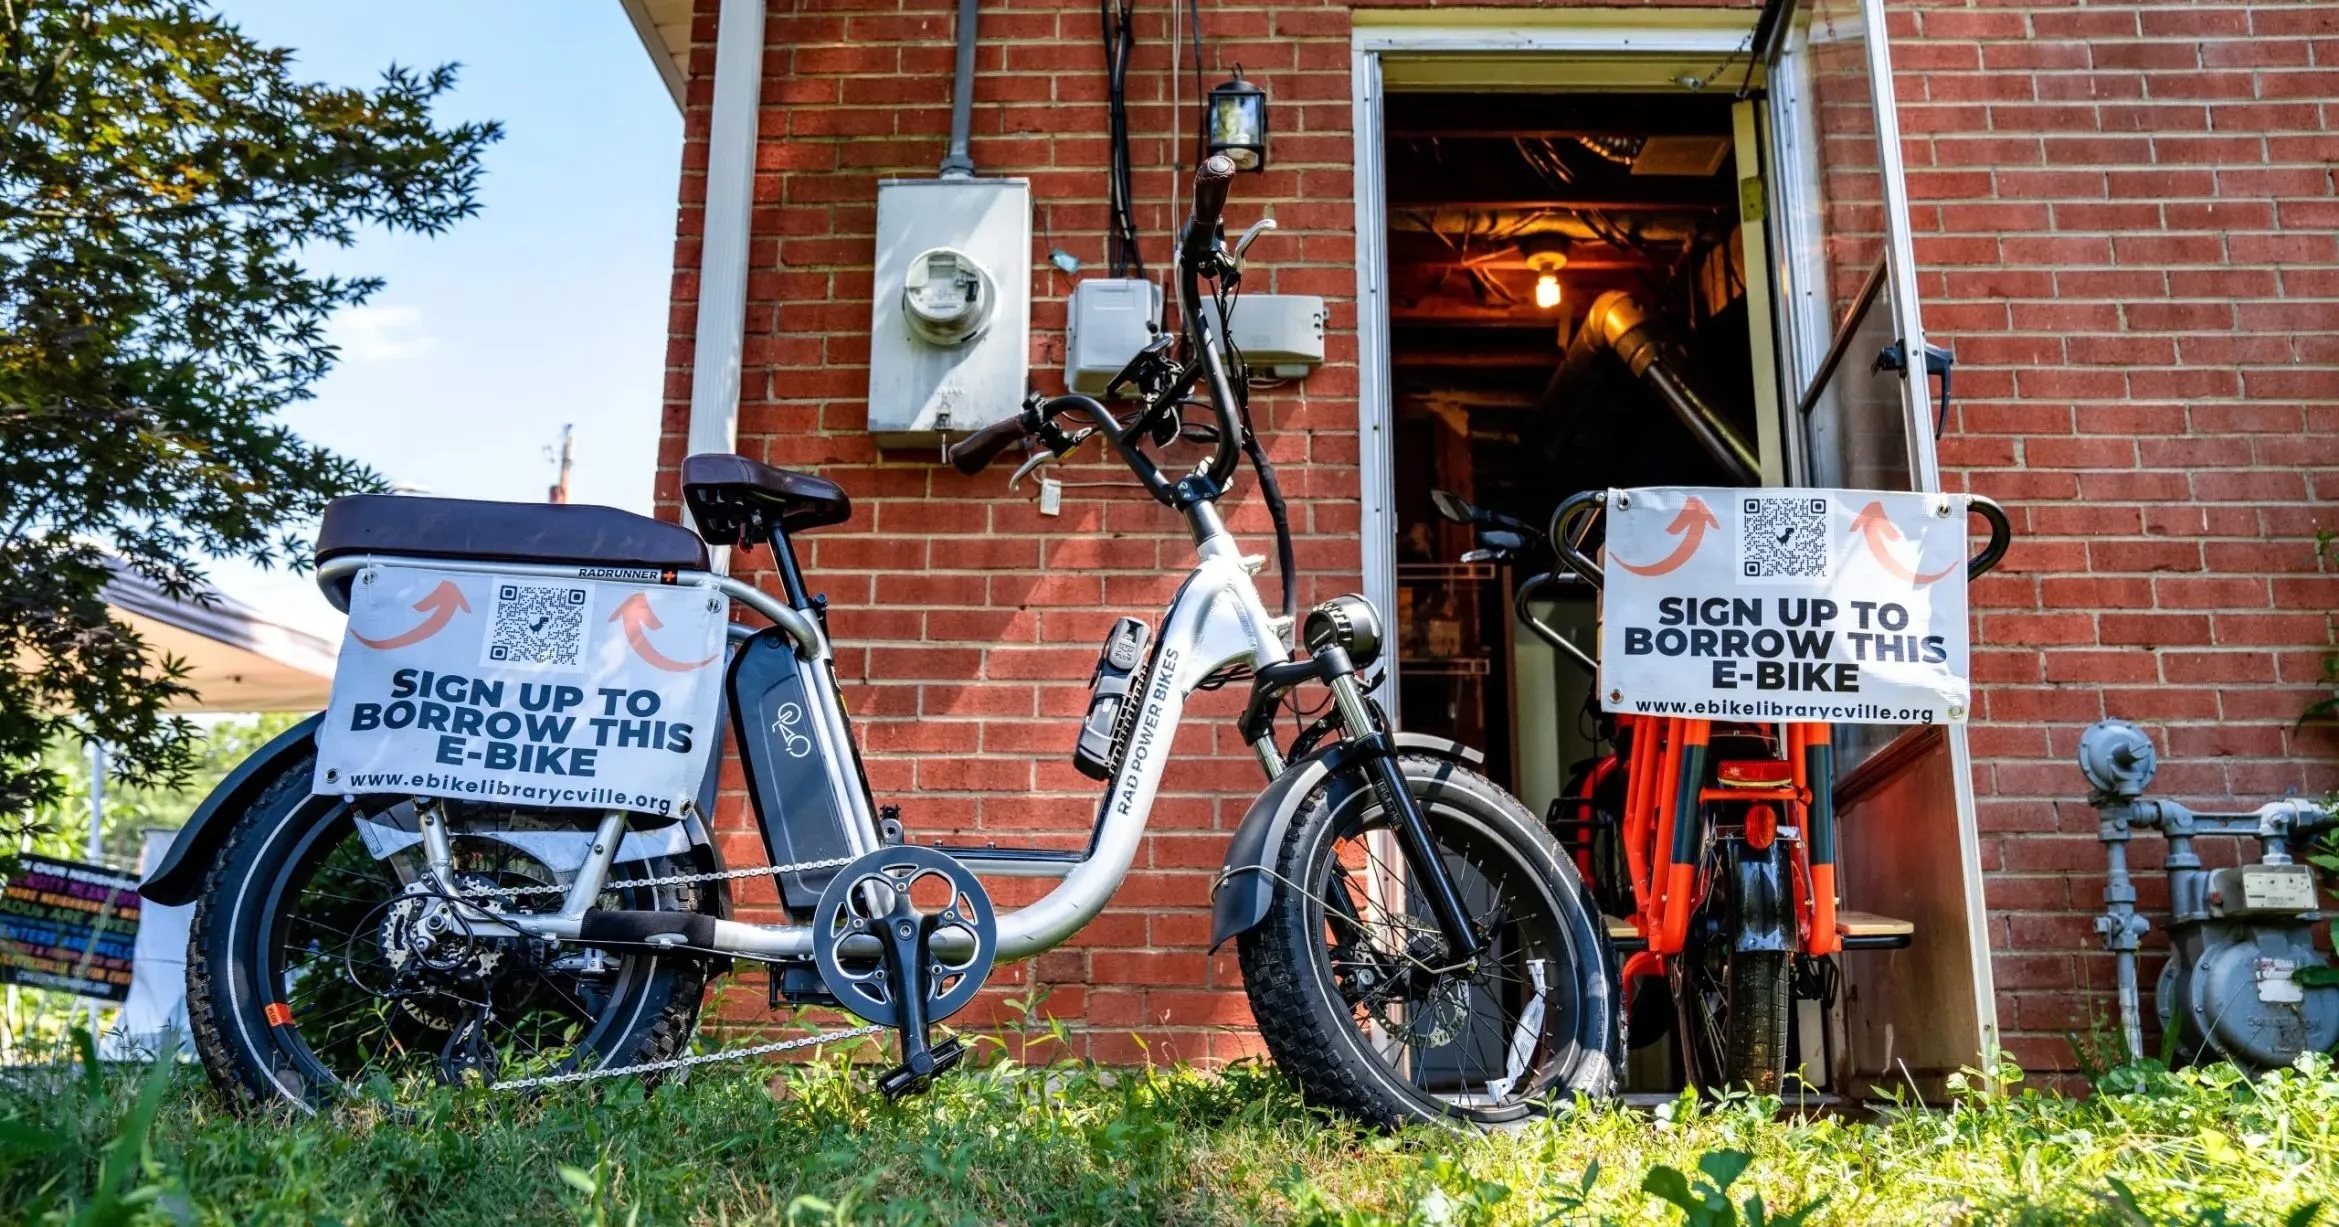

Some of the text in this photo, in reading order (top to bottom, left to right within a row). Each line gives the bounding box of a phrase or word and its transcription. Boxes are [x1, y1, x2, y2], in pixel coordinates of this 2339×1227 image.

[578, 568, 659, 580] RADRUNNER
[1658, 597, 1909, 631] SIGN UP TO
[1624, 627, 1947, 664] BORROW THIS
[391, 668, 661, 718] SIGN UP TO
[1712, 660, 1860, 693] E-BIKE
[350, 701, 694, 754] BORROW THIS
[1117, 647, 1179, 816] RAD POWER BIKES
[1635, 699, 1934, 724] www.ebikelibrarycville.org
[435, 735, 598, 778] E-BIKE
[350, 772, 672, 816] www.ebikelibrarycville.org
